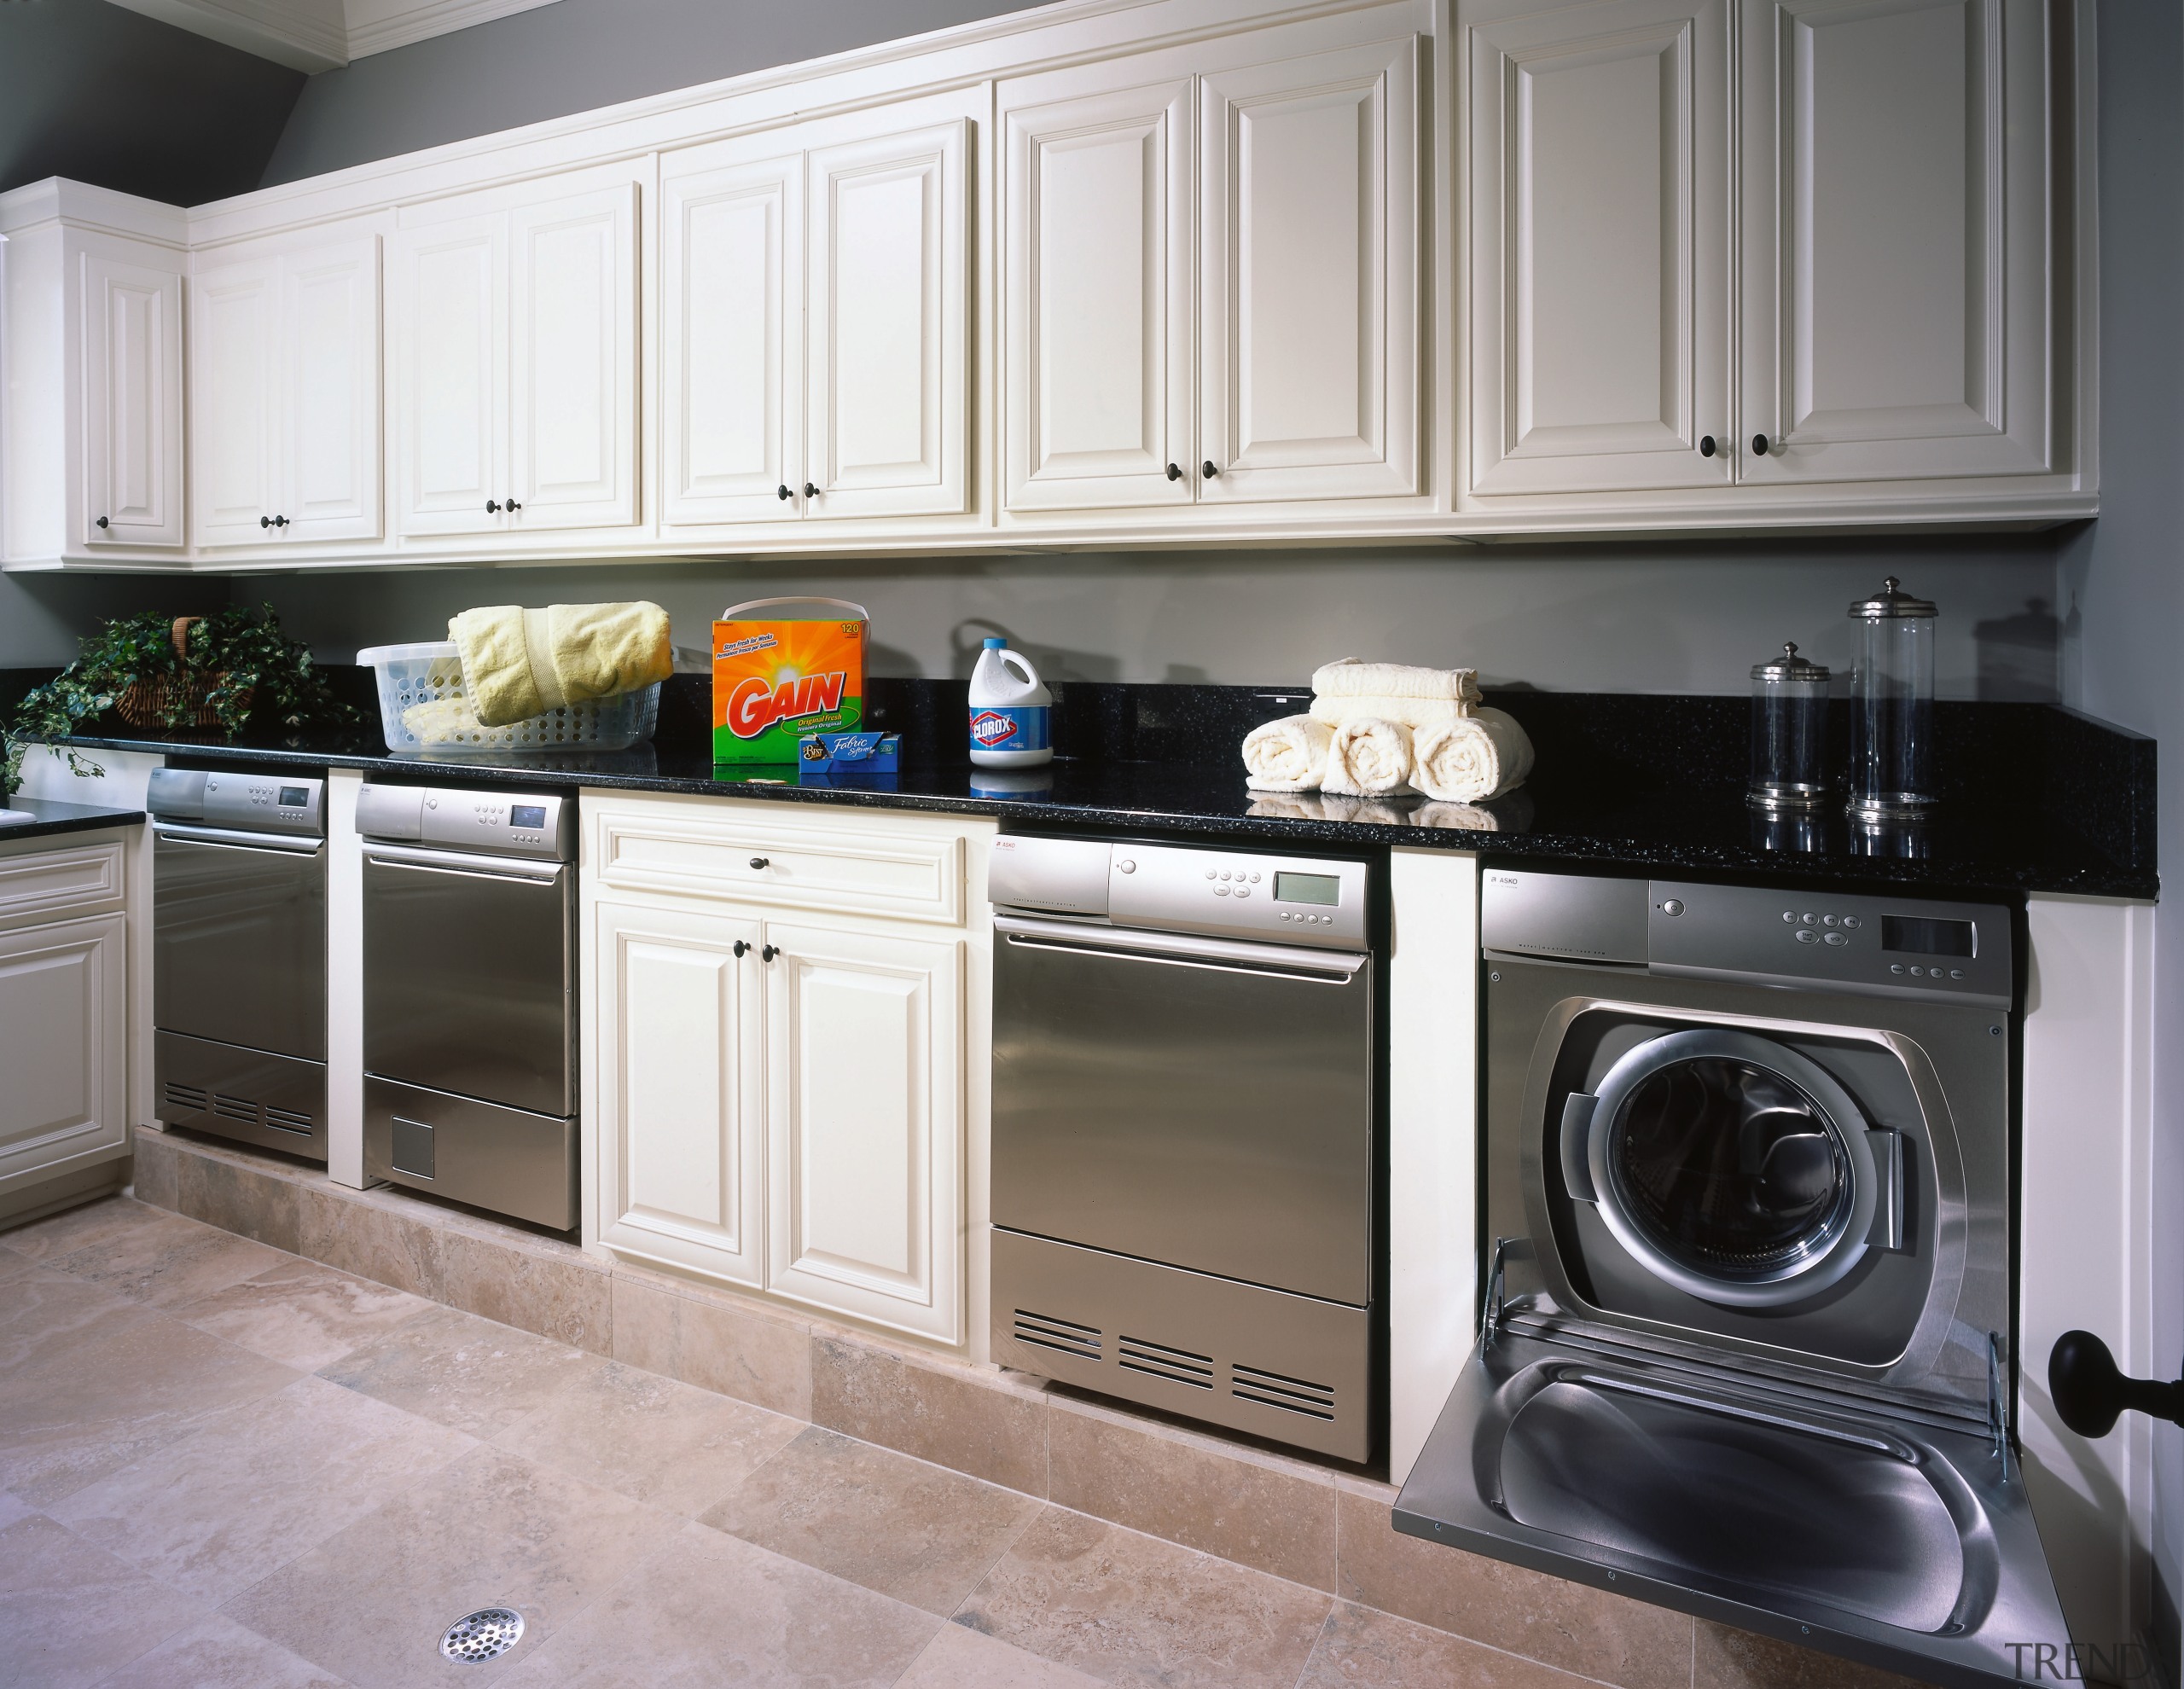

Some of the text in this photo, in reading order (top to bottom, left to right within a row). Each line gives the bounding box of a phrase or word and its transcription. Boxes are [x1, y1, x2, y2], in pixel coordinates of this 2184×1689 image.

[841, 624, 859, 633] 120
[723, 642, 736, 651] Stays
[758, 633, 773, 642] Weeks
[728, 672, 844, 738] GAIN
[798, 713, 842, 726] Original Fresh
[974, 717, 1011, 740] CLOROX
[830, 735, 868, 754] Fabric
